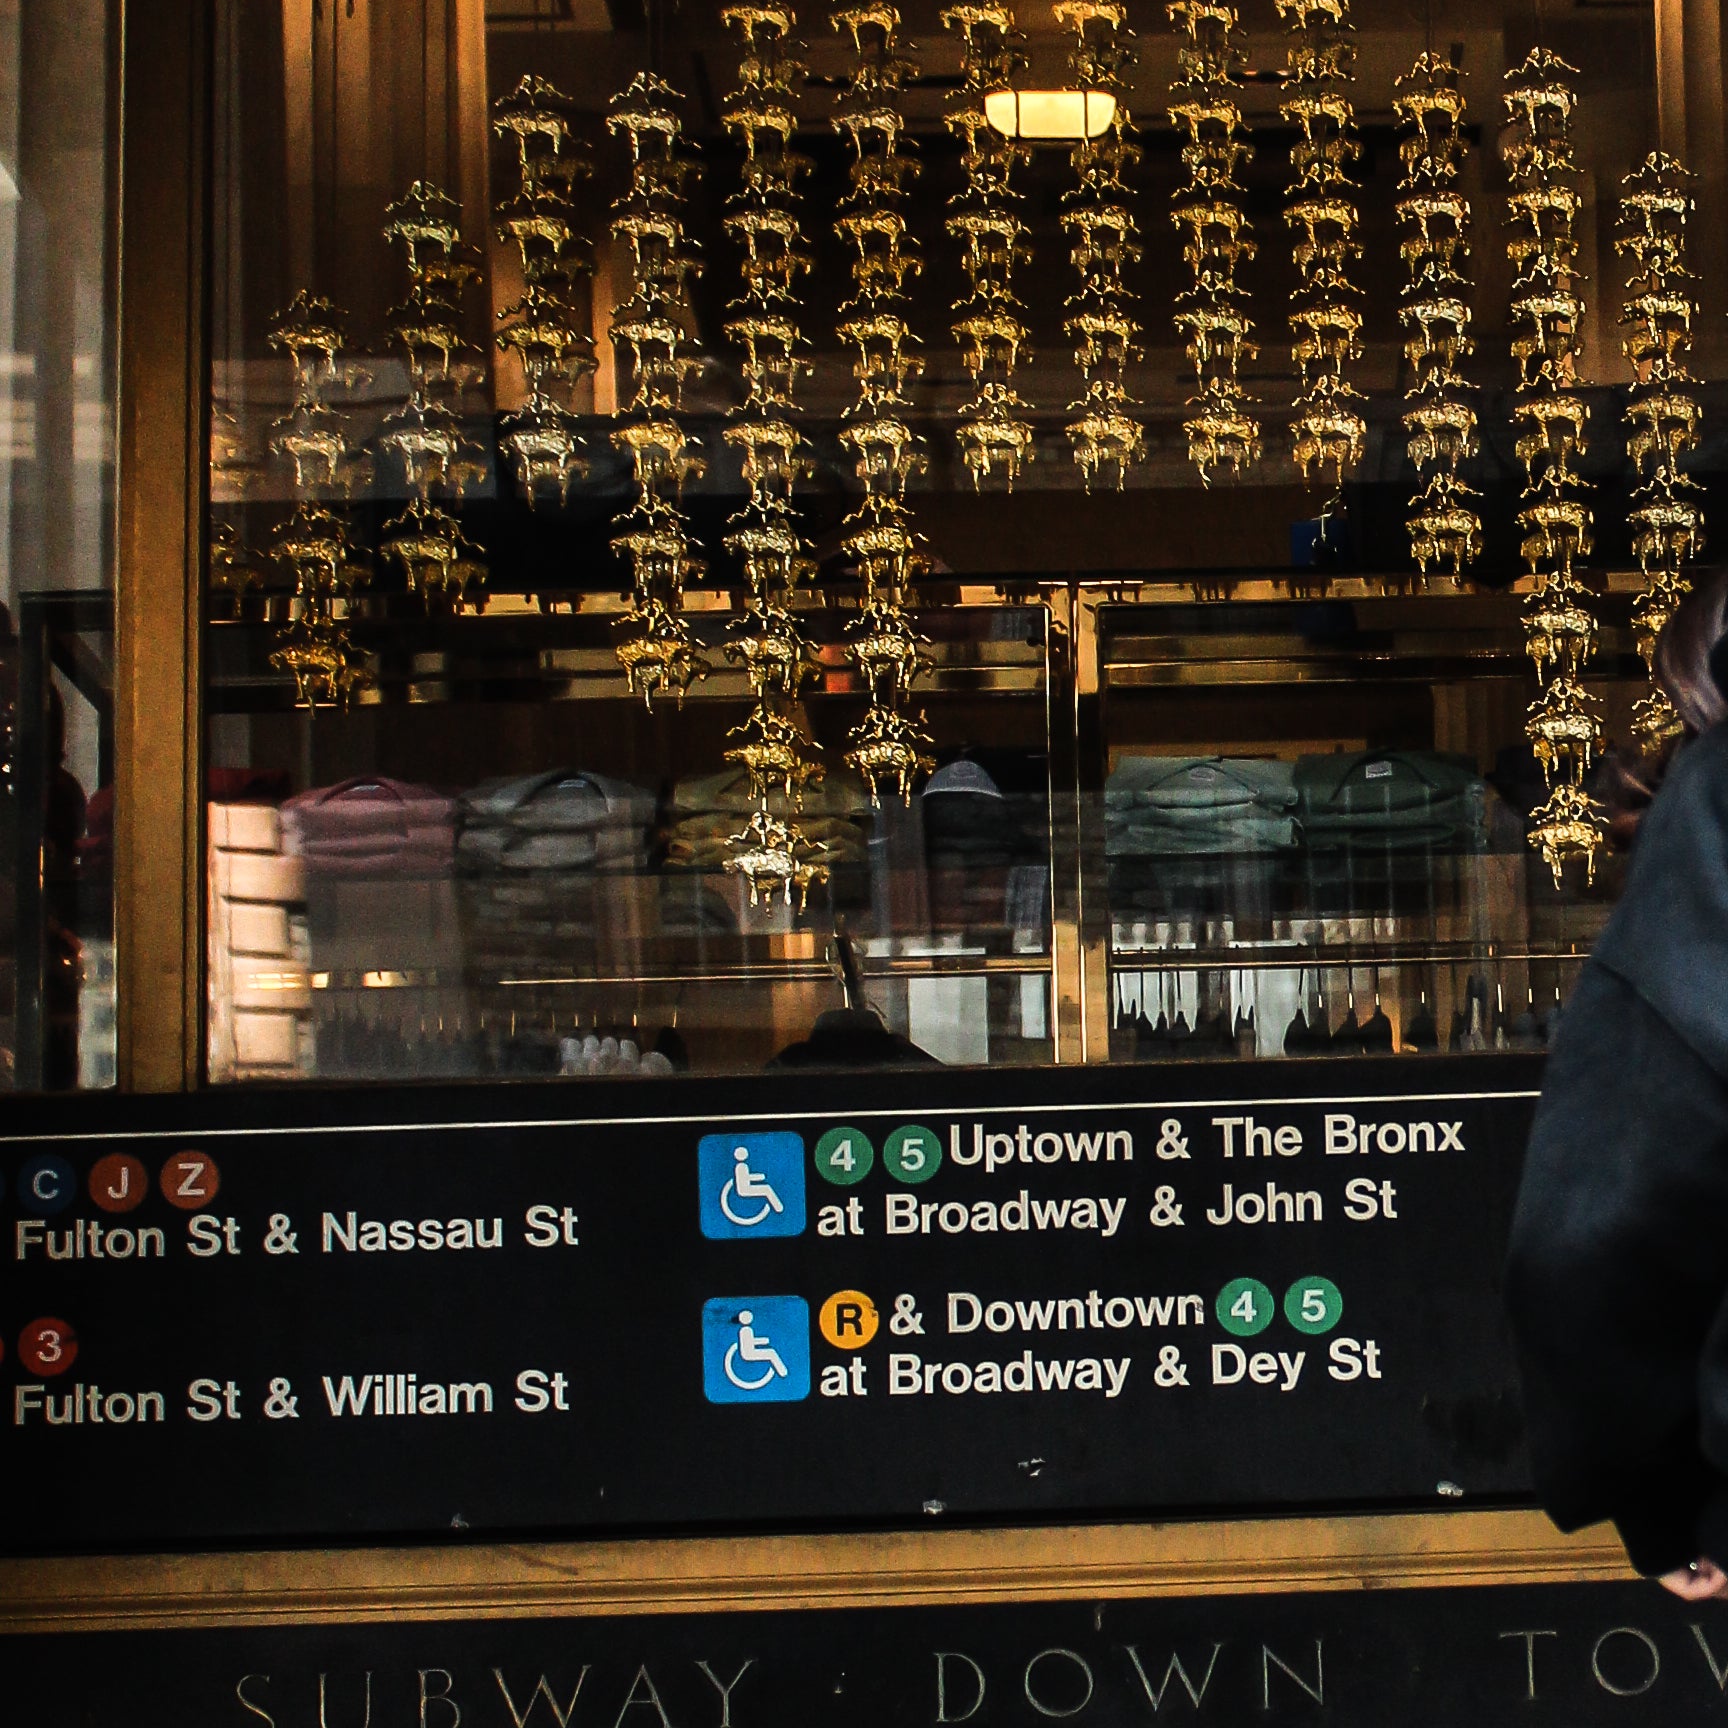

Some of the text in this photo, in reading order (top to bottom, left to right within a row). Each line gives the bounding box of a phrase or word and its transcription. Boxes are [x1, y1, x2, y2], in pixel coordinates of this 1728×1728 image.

[950, 1123, 1133, 1173] Uptown
[1156, 1118, 1192, 1160] &
[1211, 1116, 1303, 1158] The
[1324, 1113, 1466, 1155] Bronx
[16, 1204, 579, 1260] Fulton St & Nassau St
[817, 1177, 1398, 1237] at Broadway & John St
[889, 1293, 926, 1336] &
[947, 1289, 1205, 1334] Downtown
[15, 1369, 570, 1425] Fulton St & William St
[819, 1337, 1382, 1398] at Broadway & Dey St
[934, 1640, 1323, 1723] DOWN
